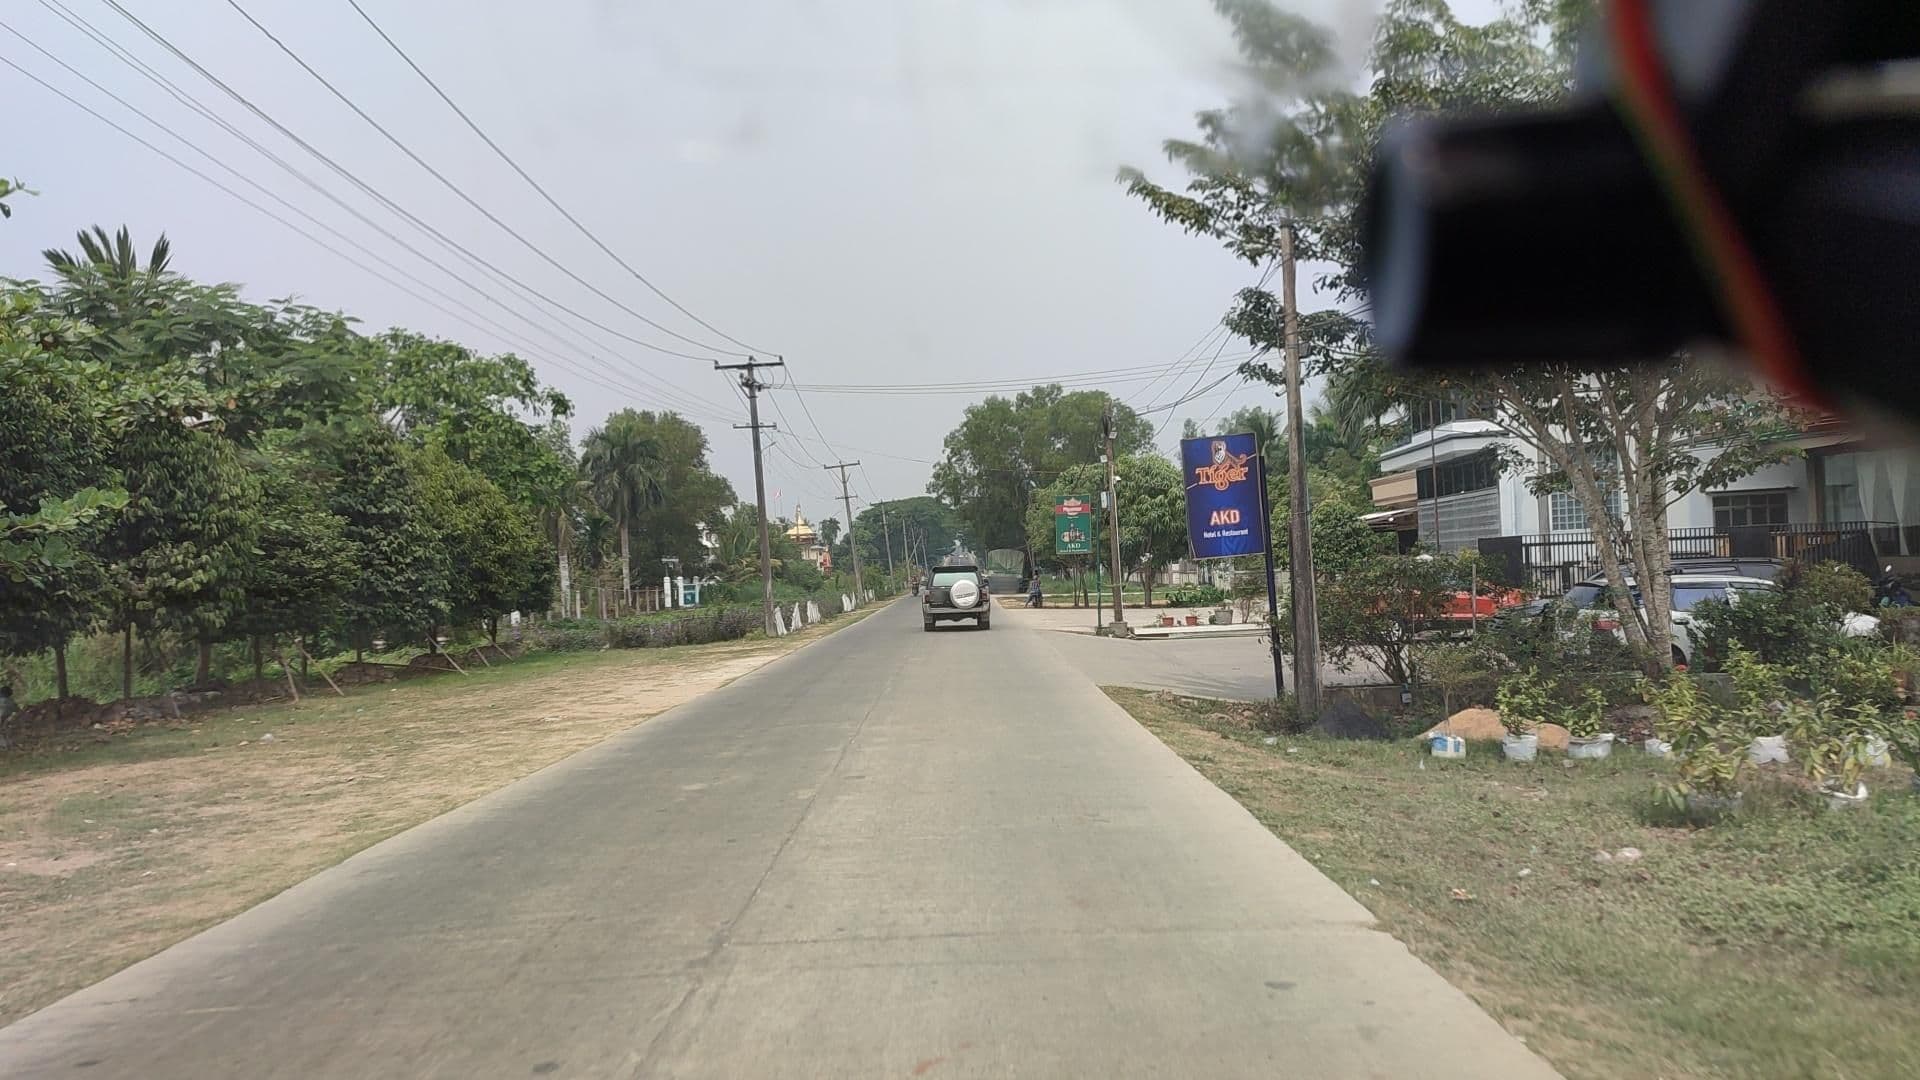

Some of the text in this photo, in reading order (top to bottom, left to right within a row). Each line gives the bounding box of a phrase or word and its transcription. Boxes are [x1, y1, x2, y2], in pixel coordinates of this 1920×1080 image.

[1195, 464, 1249, 491] Tiger
[1210, 509, 1240, 526] AKD
[1203, 530, 1217, 538] Hotel
[1221, 529, 1249, 537] Restaurant
